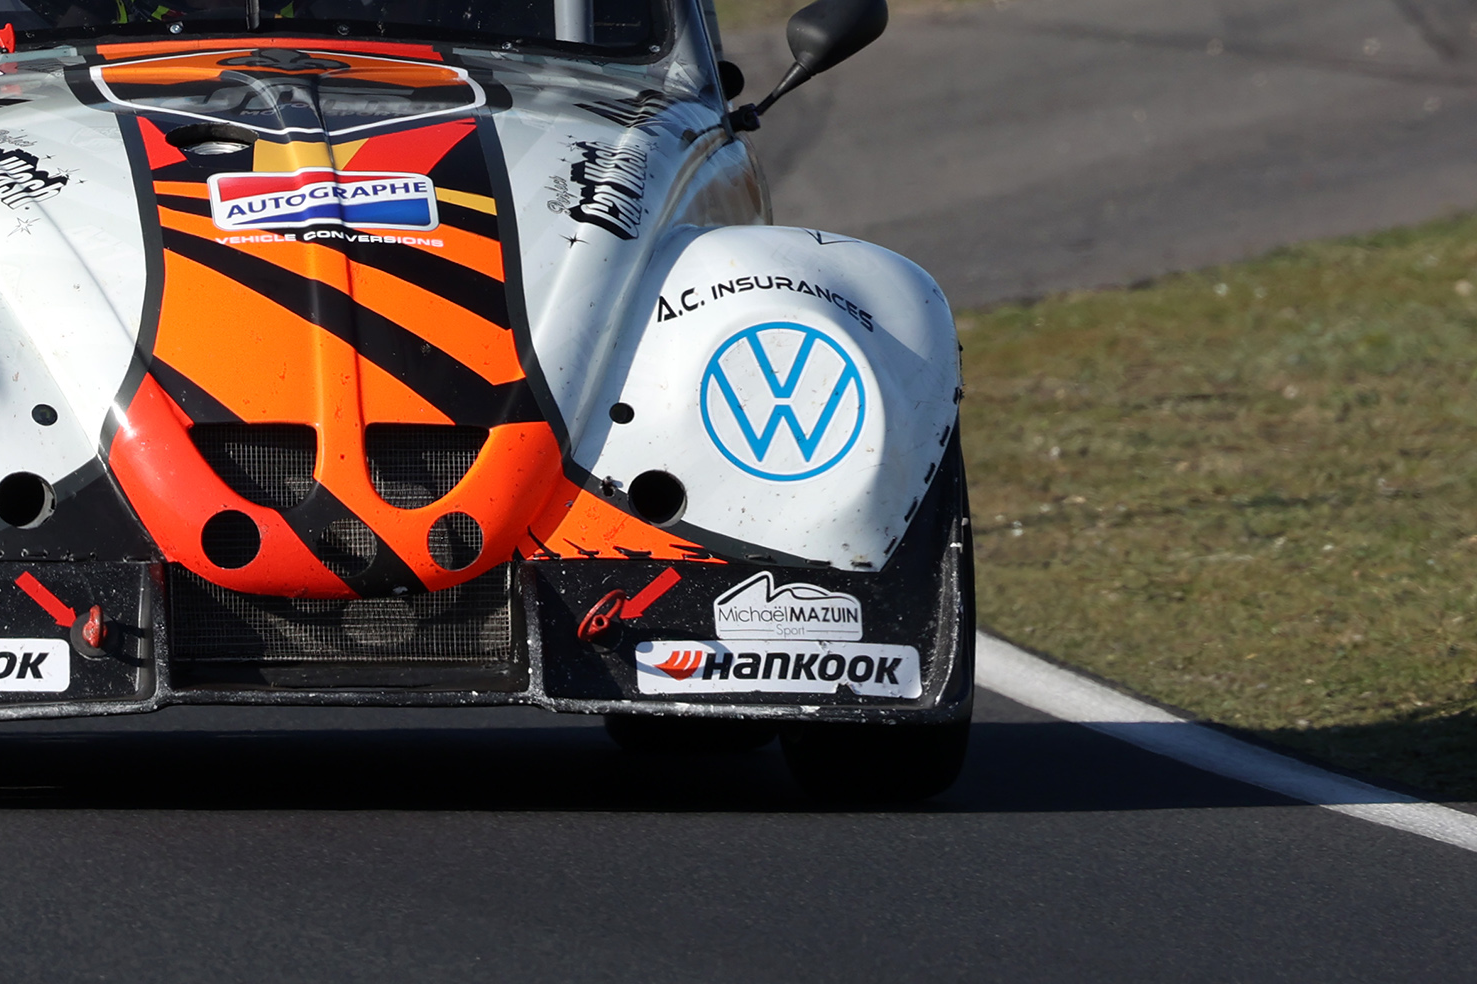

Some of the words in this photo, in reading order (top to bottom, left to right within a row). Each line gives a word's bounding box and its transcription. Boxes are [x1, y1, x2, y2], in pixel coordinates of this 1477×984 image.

[226, 181, 429, 220] AUTOGRAPHE
[215, 233, 297, 245] VEHICLE
[303, 230, 445, 248] CONVERSIONS
[657, 287, 705, 323] A.C.
[711, 275, 874, 333] INSURANCES
[700, 321, 866, 482] VW
[776, 624, 806, 638] Sport
